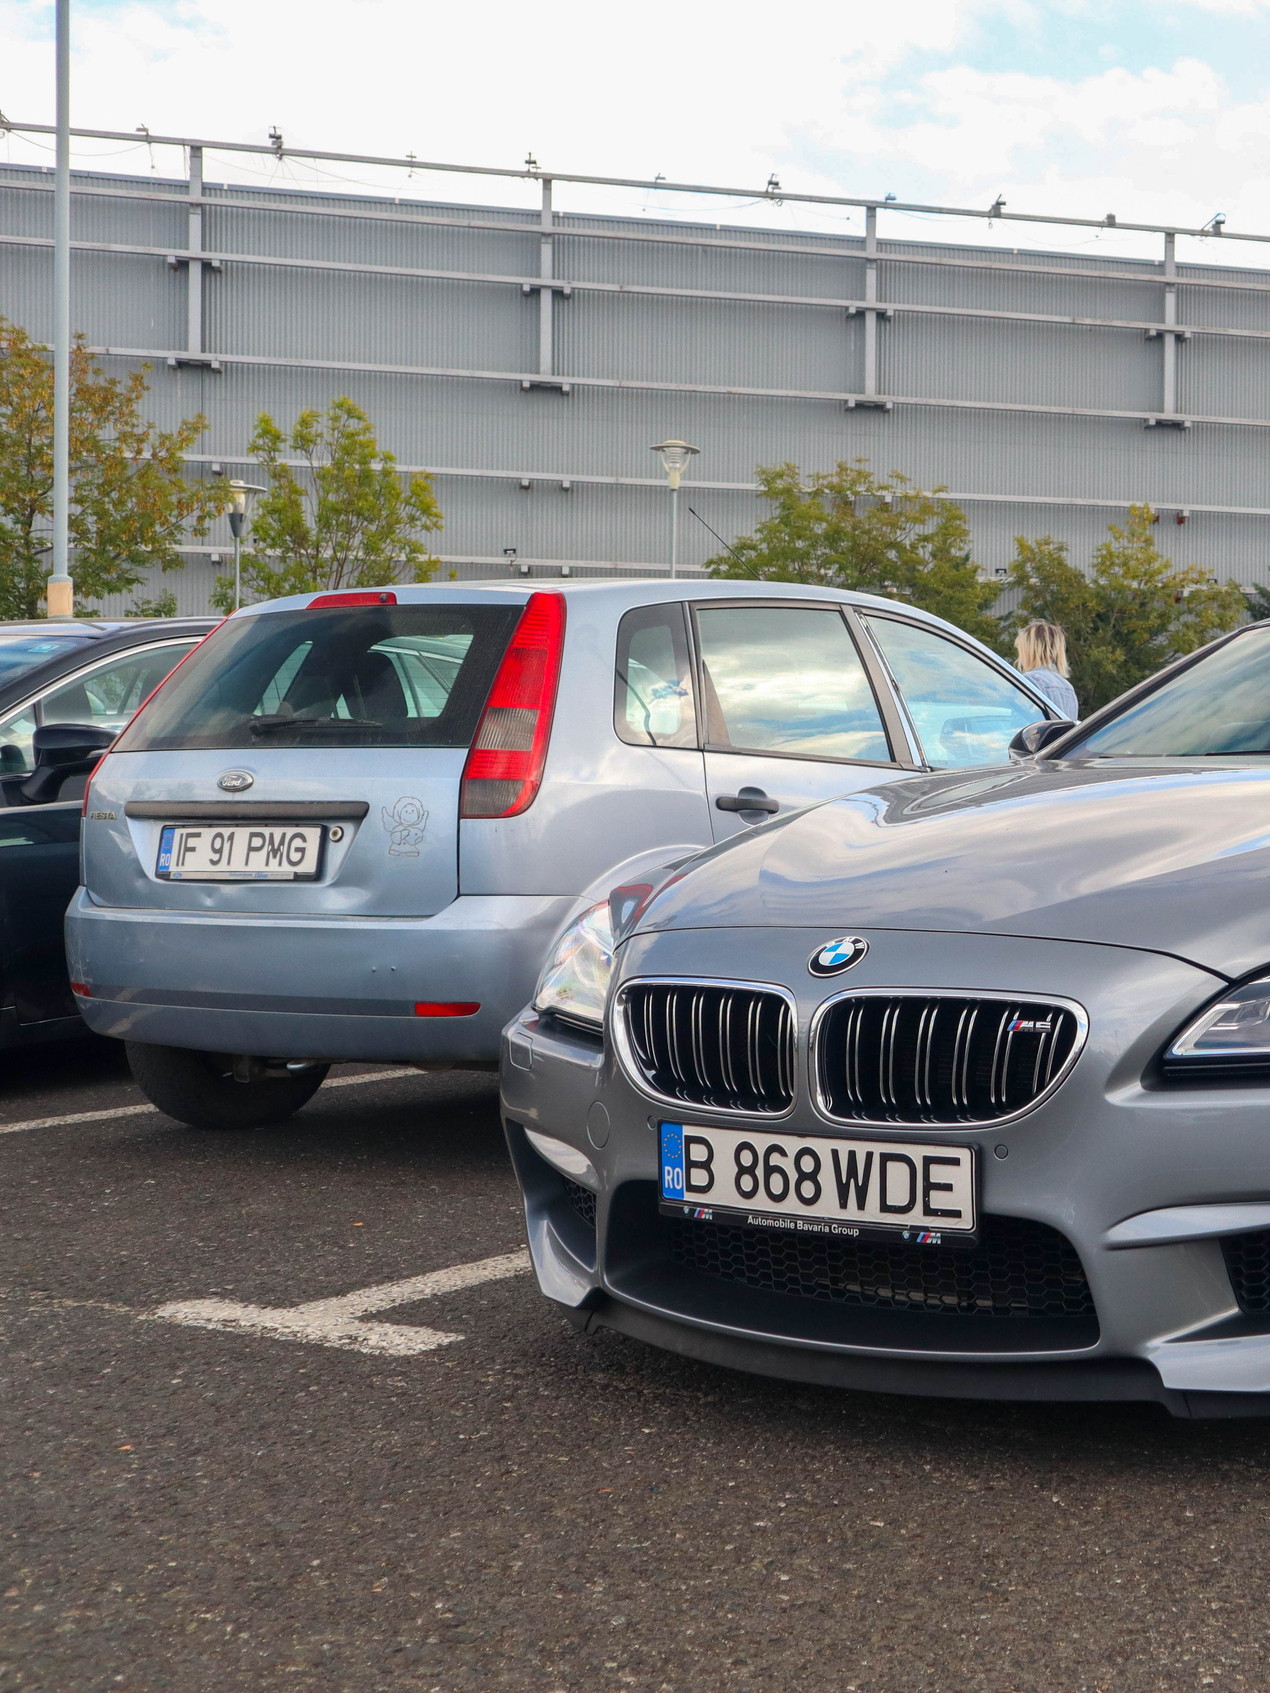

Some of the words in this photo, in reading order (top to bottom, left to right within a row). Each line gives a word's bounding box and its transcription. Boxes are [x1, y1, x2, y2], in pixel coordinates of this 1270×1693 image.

[159, 853, 171, 867] RO
[175, 832, 202, 867] IF
[208, 831, 235, 867] 91
[244, 831, 307, 867] PMG
[664, 1165, 683, 1191] RO
[684, 1134, 715, 1195] B
[733, 1140, 822, 1207] 868
[830, 1147, 962, 1220] WDE
[747, 1215, 796, 1230] Automobile
[796, 1220, 830, 1233] Bavaria
[831, 1224, 860, 1238] Group
